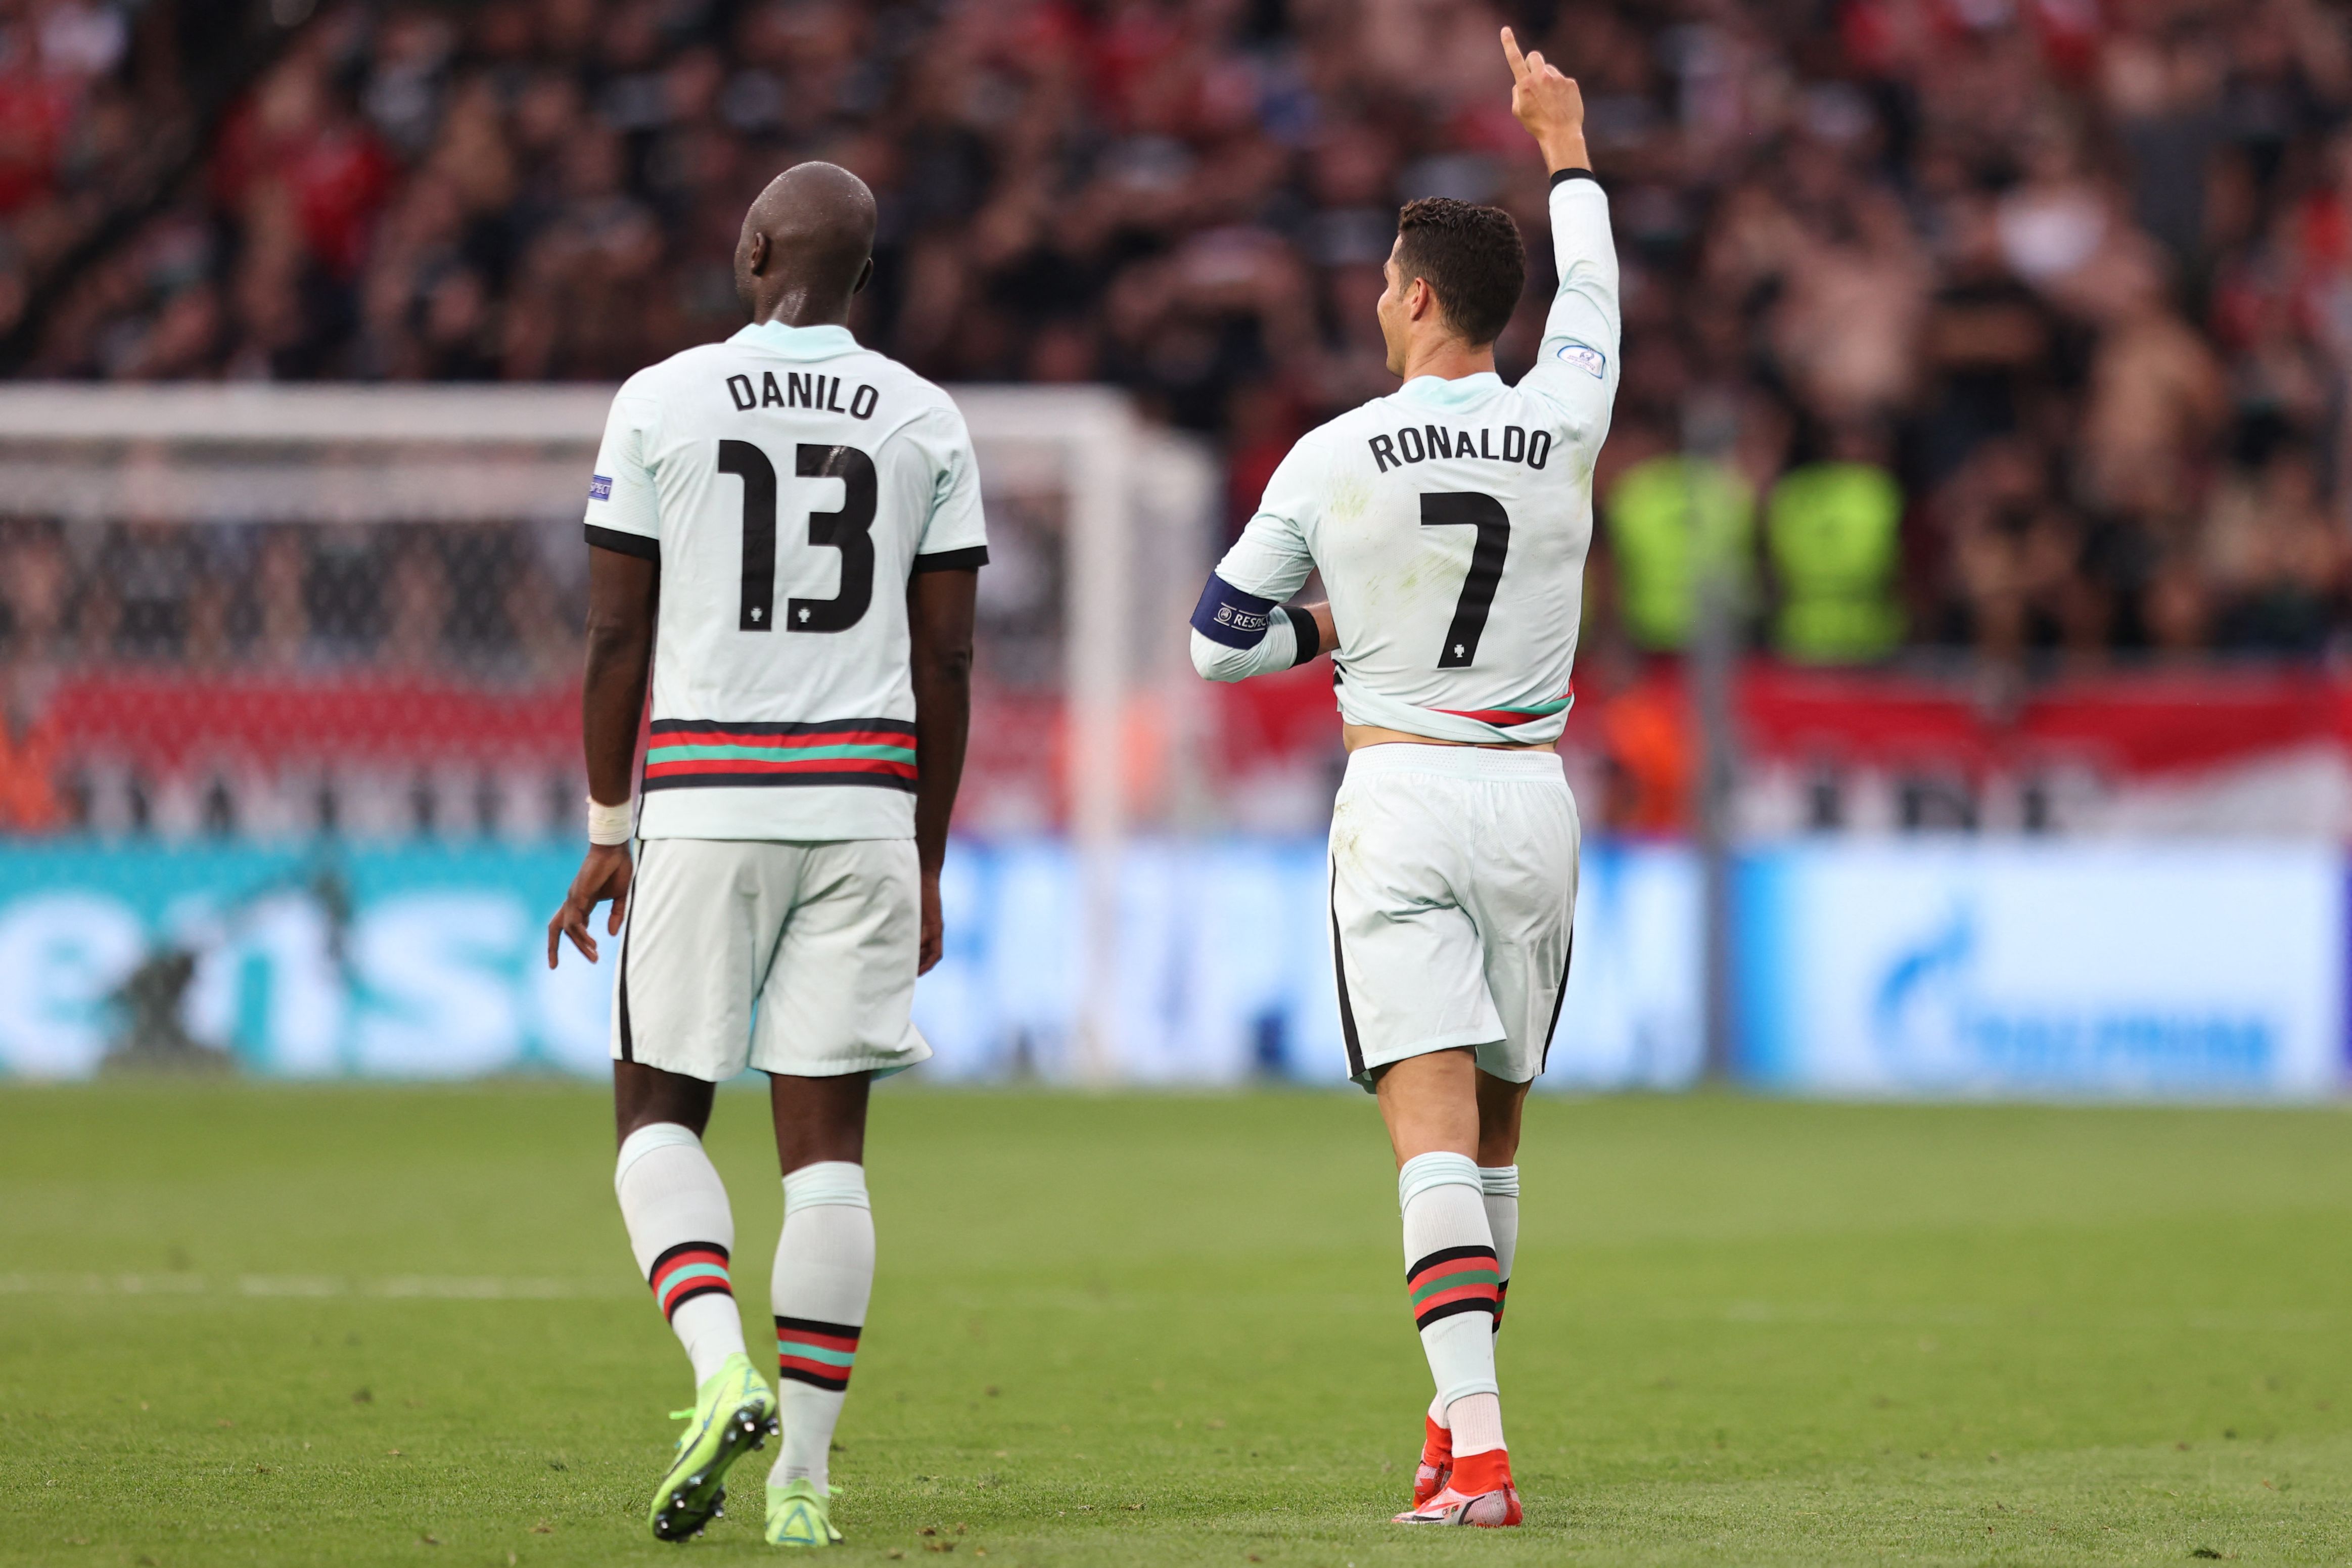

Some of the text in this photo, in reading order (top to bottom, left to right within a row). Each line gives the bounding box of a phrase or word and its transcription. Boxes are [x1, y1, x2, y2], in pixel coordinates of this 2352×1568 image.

[726, 371, 880, 421] DANILO
[1368, 425, 1552, 473] RONALDO
[717, 439, 878, 633] 13
[1419, 491, 1510, 669] 7
[1233, 613, 1269, 628] RESCT
